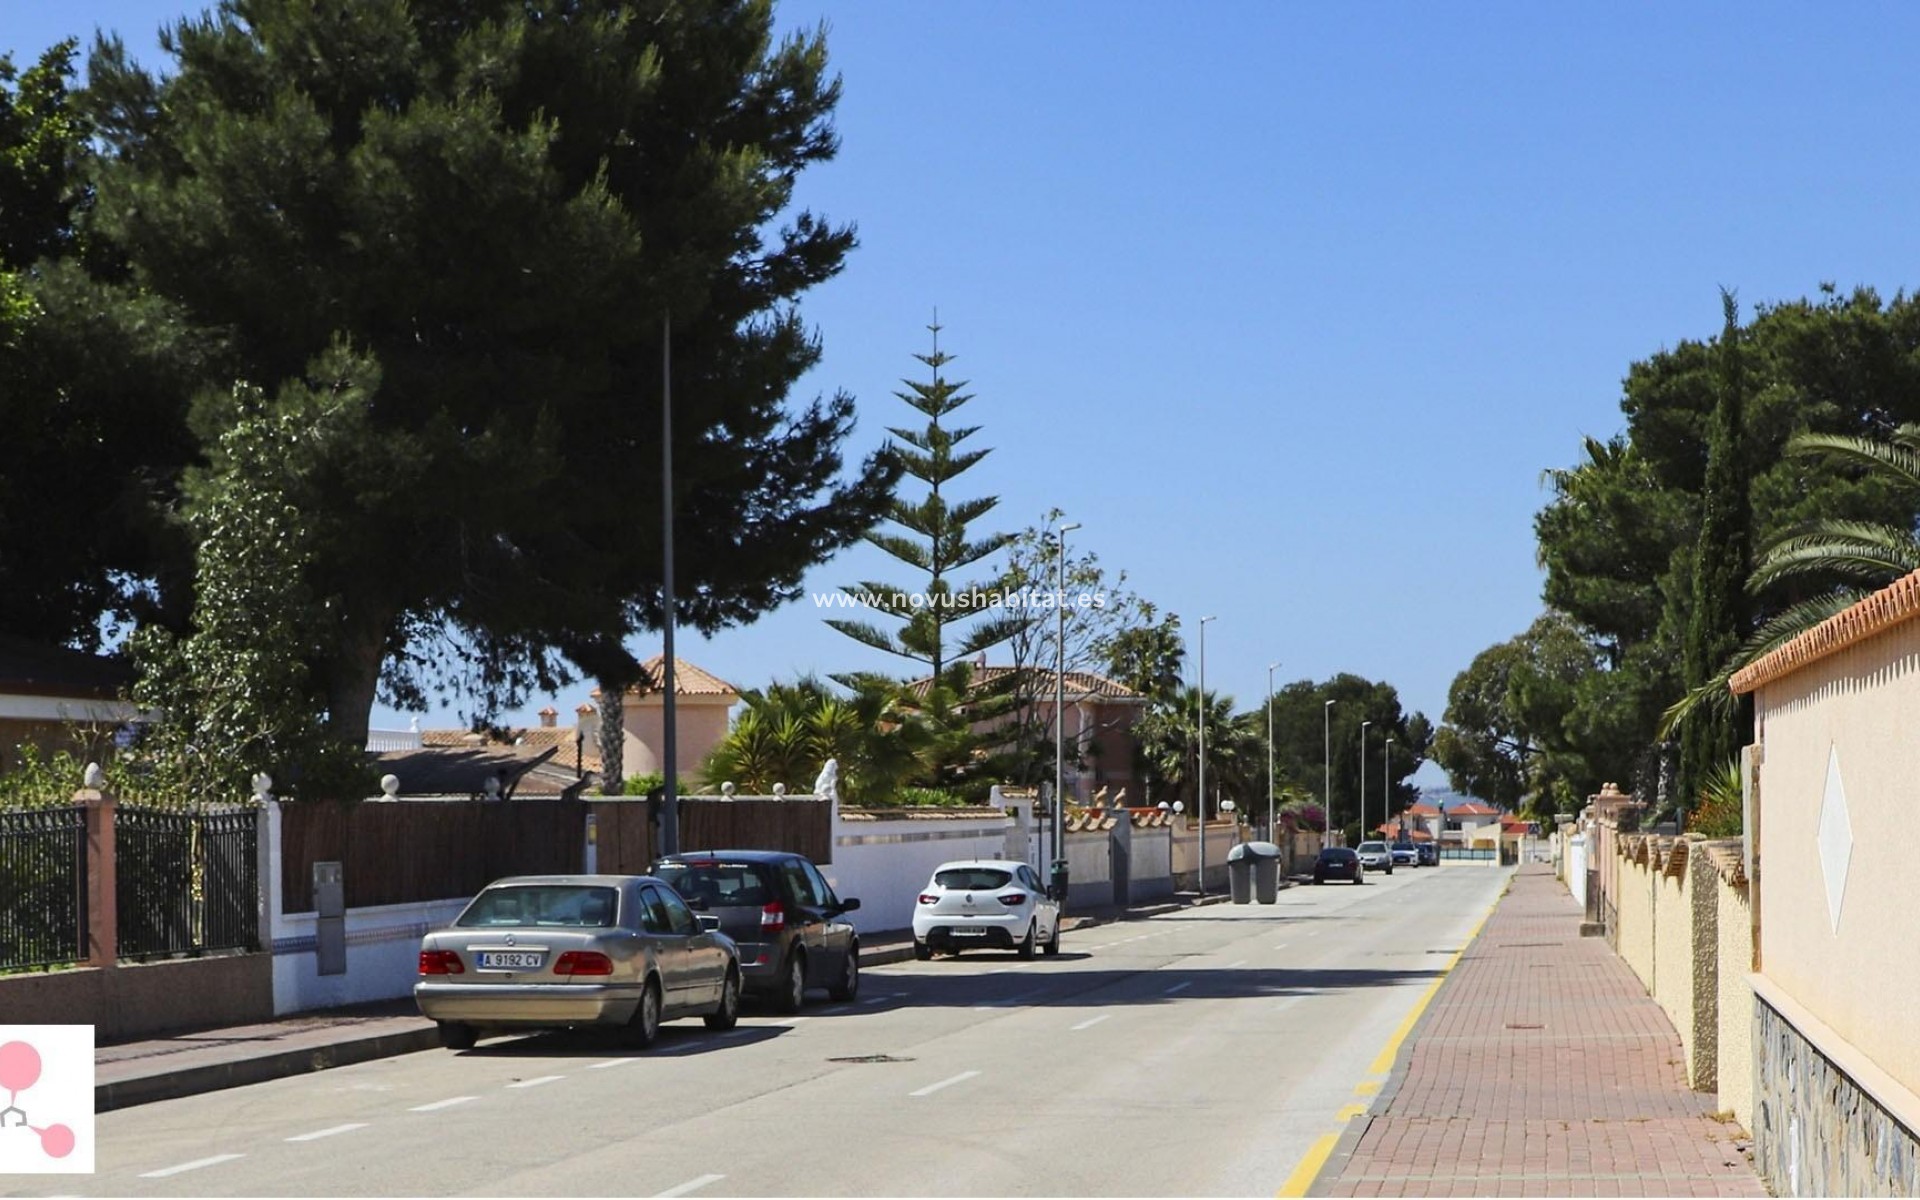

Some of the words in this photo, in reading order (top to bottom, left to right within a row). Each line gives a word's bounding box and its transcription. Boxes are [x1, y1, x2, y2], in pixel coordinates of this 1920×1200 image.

[485, 955, 491, 966] A
[495, 954, 522, 966] 9192
[526, 954, 540, 966] CV
